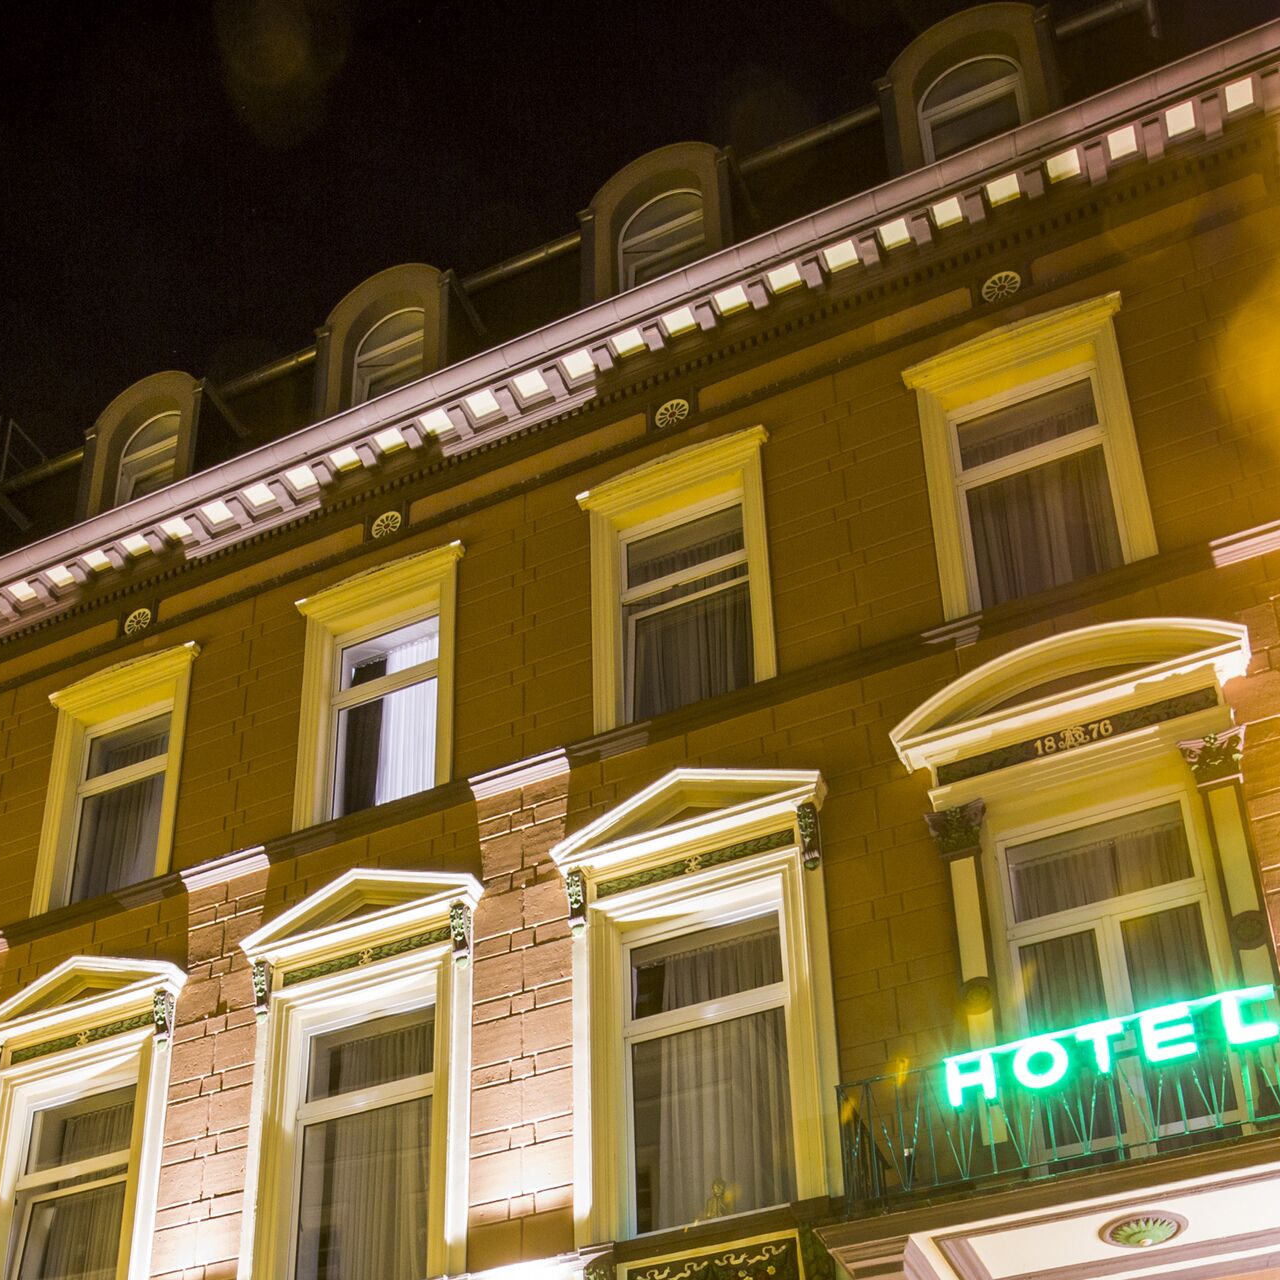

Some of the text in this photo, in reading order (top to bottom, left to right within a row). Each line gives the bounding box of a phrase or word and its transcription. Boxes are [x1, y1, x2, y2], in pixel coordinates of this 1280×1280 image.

[1034, 736, 1056, 755] 18
[1088, 719, 1113, 739] 76
[944, 993, 1280, 1107] HOTEL
